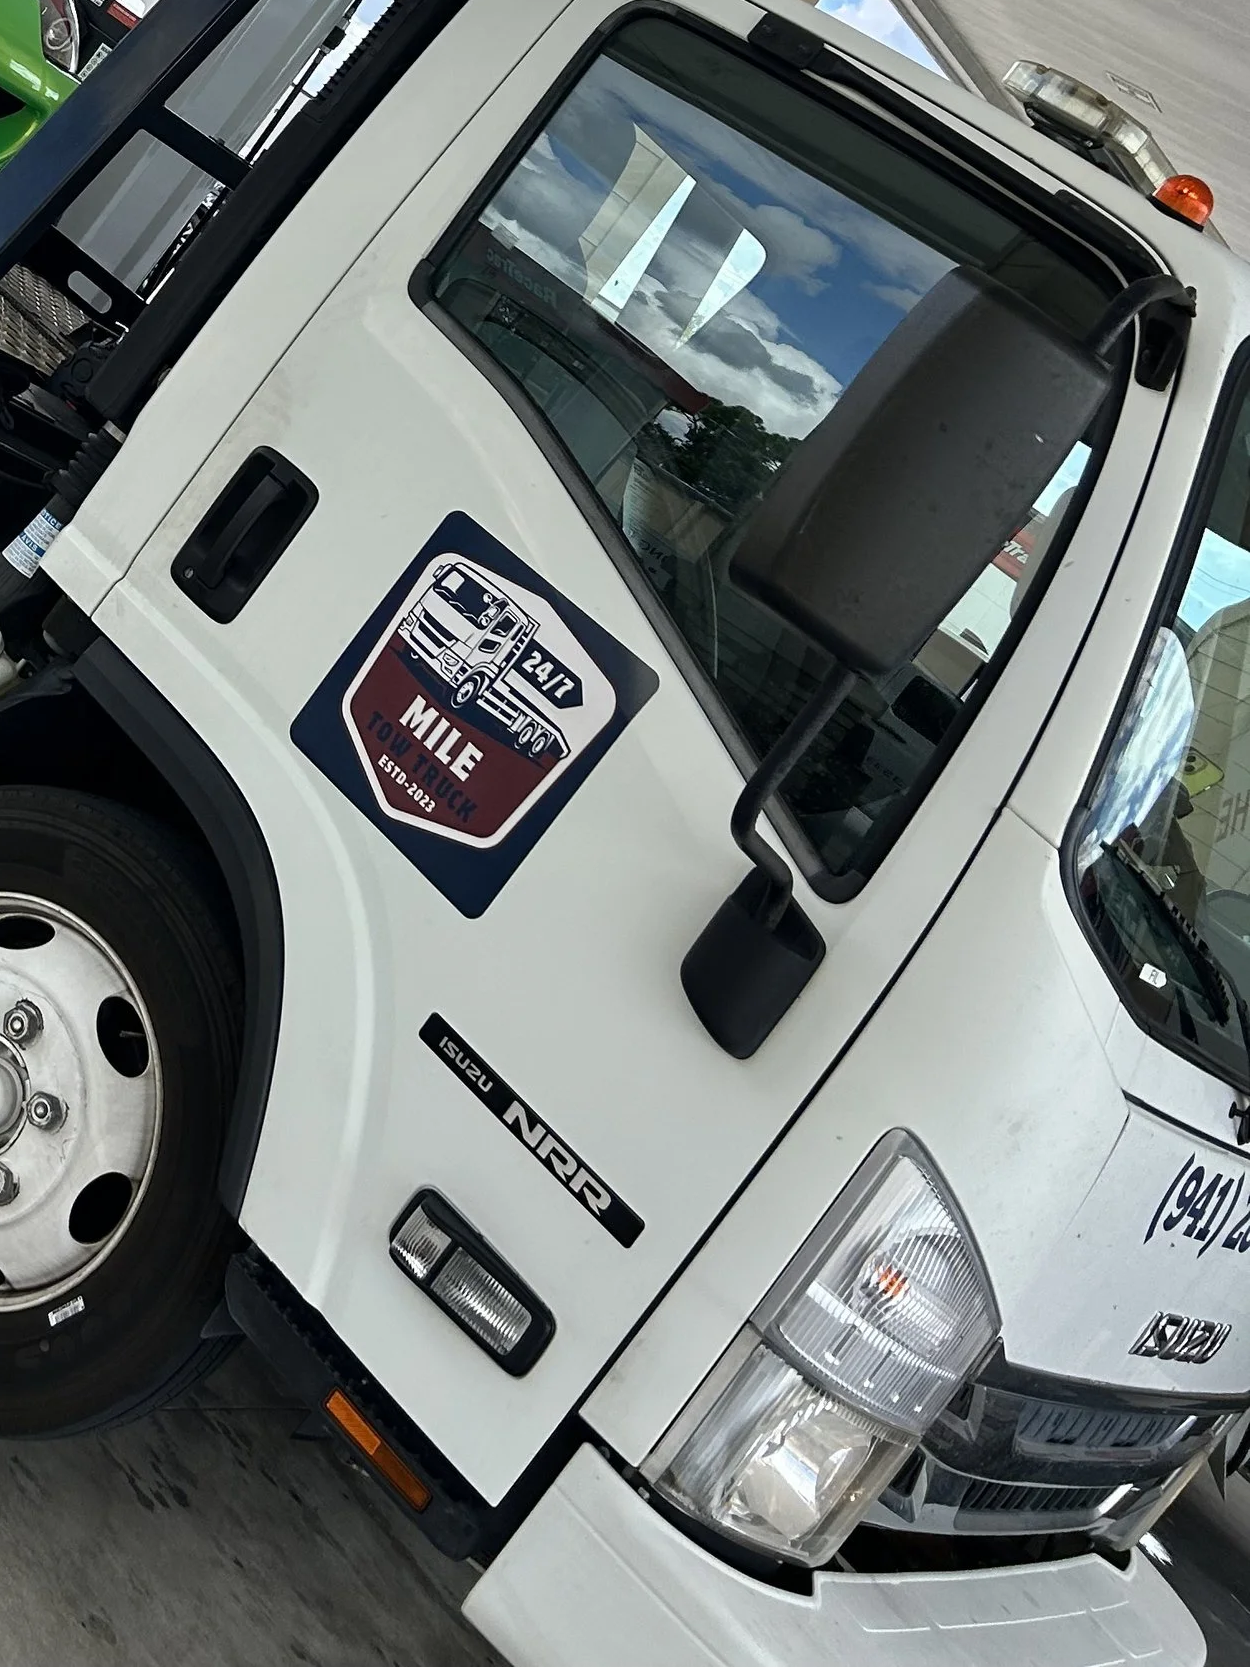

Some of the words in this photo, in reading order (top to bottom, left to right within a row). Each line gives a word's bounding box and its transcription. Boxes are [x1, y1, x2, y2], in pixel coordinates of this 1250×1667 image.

[521, 650, 575, 699] 24/7
[366, 710, 413, 758] TOW
[411, 753, 478, 824] TRUCK
[399, 694, 484, 782] MILE
[377, 753, 437, 814] ESTD-2023
[438, 1036, 493, 1093] ISUZU
[502, 1100, 612, 1217] NRR
[1143, 1152, 1245, 1258] (941)
[1128, 1311, 1232, 1365] ISUZU
